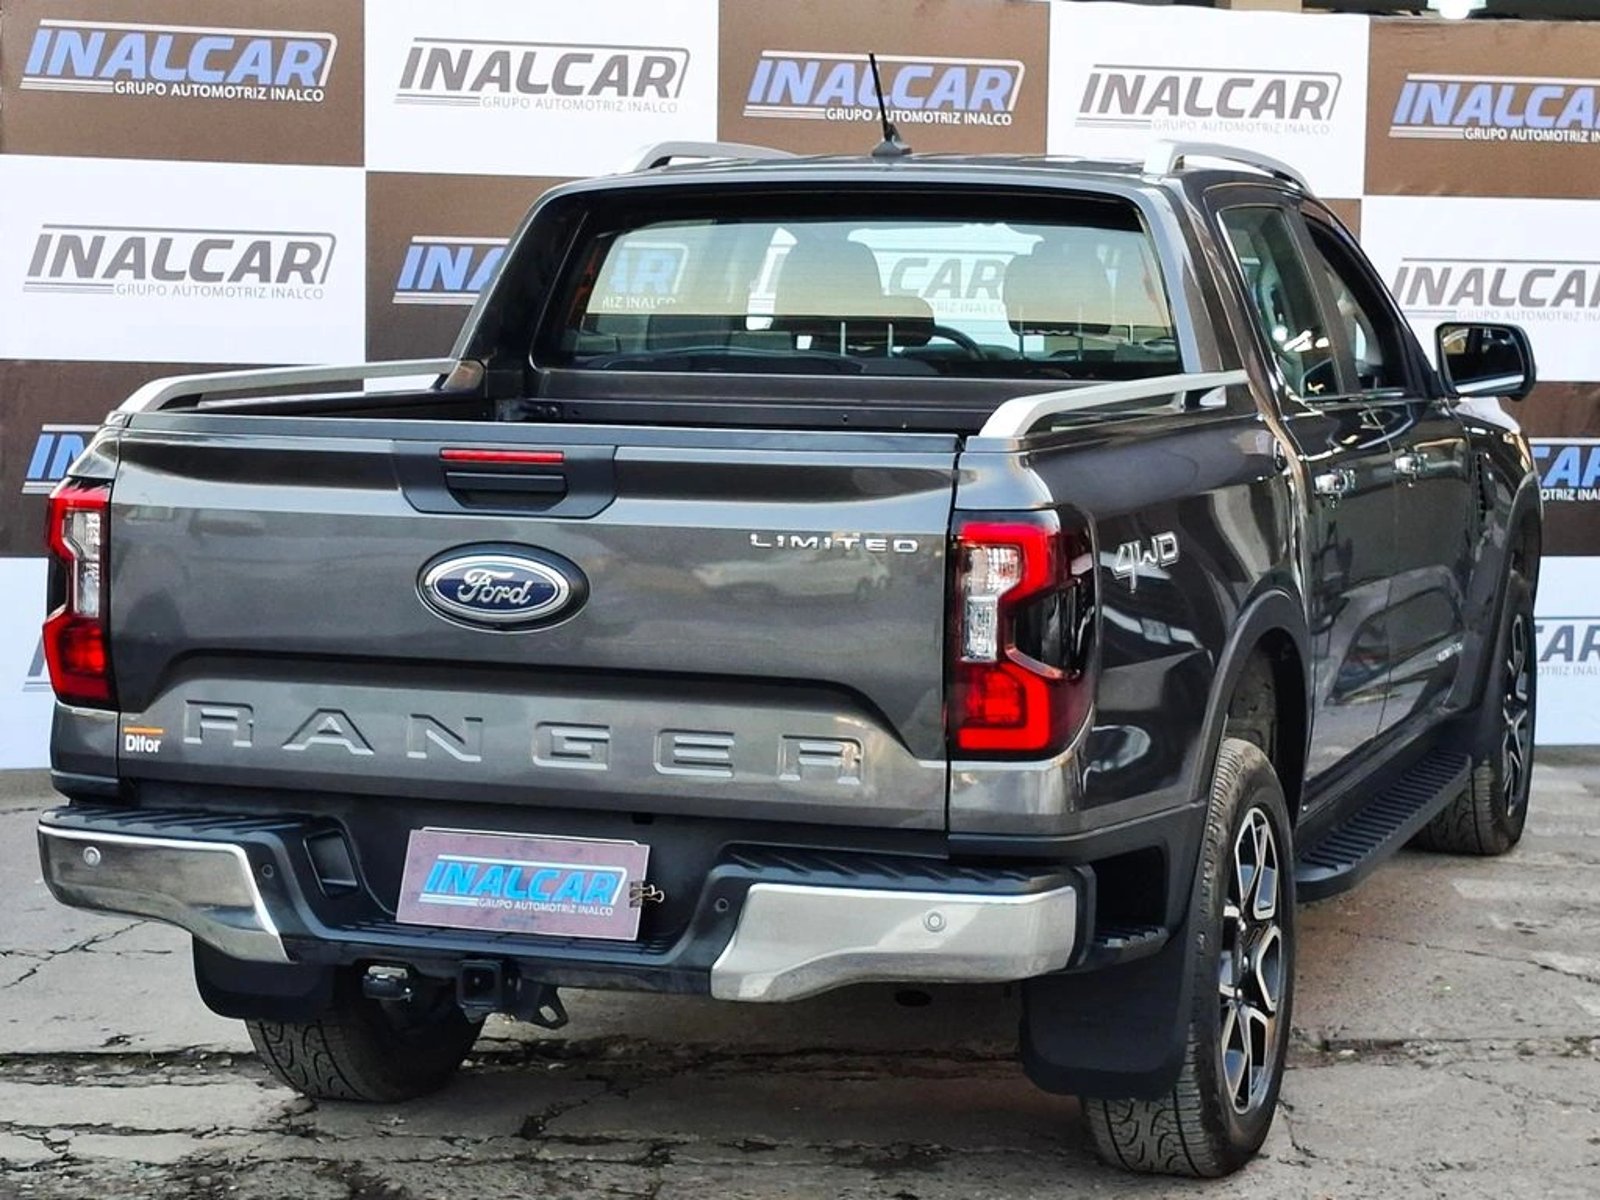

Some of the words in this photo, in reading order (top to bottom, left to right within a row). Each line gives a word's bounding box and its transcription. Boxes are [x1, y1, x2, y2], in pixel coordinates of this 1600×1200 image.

[24, 29, 325, 87] INALCAR
[399, 47, 678, 98] INALCAR
[115, 81, 167, 96] GRUPO
[170, 84, 267, 100] AUTOMOTRIZ
[271, 88, 324, 102] INALCO
[748, 60, 1013, 111] INALCAR
[1079, 73, 1330, 120] INALCAR
[482, 97, 531, 109] GRUPO
[535, 98, 625, 112] AUTOMOTRIZ
[628, 101, 678, 113] INALCO
[826, 107, 872, 121] GRUPO
[964, 113, 1012, 126] INALCO
[1392, 82, 1600, 129] INALCA
[1153, 119, 1197, 131] GRUPO
[1201, 121, 1282, 134] AUTOMOTRIZ
[1284, 123, 1331, 135] INALCO
[1465, 128, 1507, 140] GRUPO
[1510, 129, 1589, 143] AUTOMOTRIZ
[27, 234, 325, 284] INALCAR
[116, 283, 167, 297] GRUPO
[173, 285, 267, 299] AUTOMOTRIZ
[271, 287, 324, 300] INALCO
[1391, 267, 1600, 308] INALCA
[1459, 310, 1500, 320] GRUPO
[1504, 310, 1580, 322] AUTOMOTRIZ
[750, 533, 919, 553] LIMITED
[1112, 531, 1178, 593] 4WD
[457, 568, 535, 605] Ford
[125, 734, 161, 753] Difor
[184, 699, 864, 785] RANGER
[424, 860, 618, 905] INALCAR
[479, 898, 512, 910] GRUPO
[514, 900, 576, 914] AUTOMOTRIZ
[577, 905, 613, 916] INALCO
